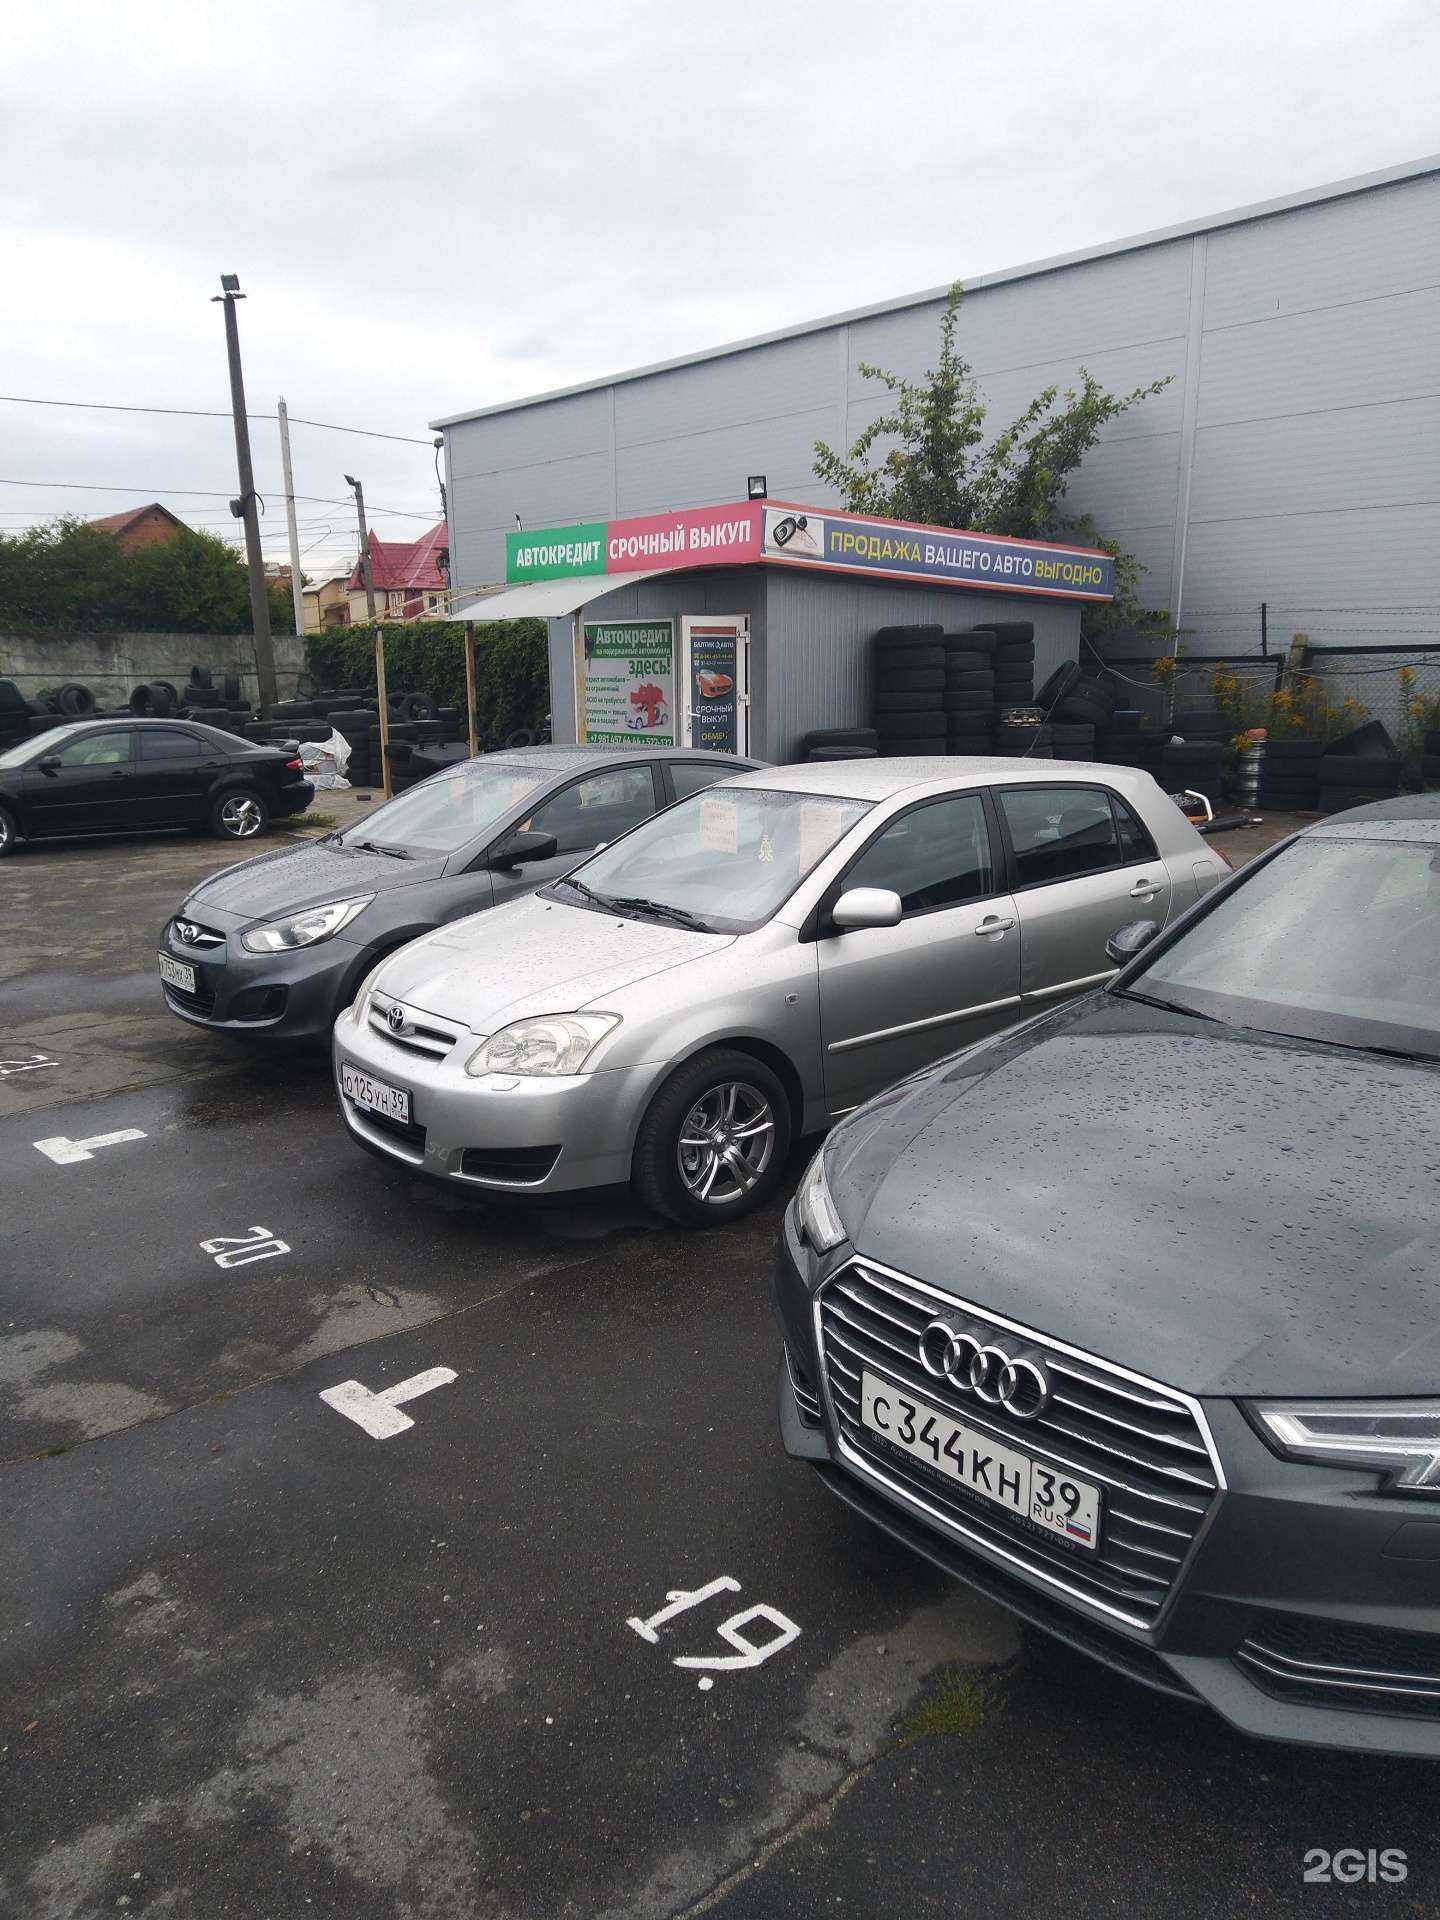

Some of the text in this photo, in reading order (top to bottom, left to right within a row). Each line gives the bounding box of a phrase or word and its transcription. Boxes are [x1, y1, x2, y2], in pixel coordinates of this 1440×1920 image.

[609, 519, 751, 560] СРОЧНЫЙ ВЫКУП
[516, 540, 600, 568] АВТОКРЕДИТ
[830, 531, 1102, 585] ПРОДАЖА ВАШЕГО АВТО ВЫГОДНО
[595, 627, 670, 648] Автокредит
[628, 655, 671, 678] здесь!
[695, 704, 733, 713] СРОЧНЫЙ
[701, 715, 728, 724] ВЫКУП
[346, 1075, 404, 1112] О125УН 39
[200, 1226, 291, 1268] 20
[873, 1396, 1082, 1518] С344КН 39
[1034, 1503, 1065, 1528] RUS
